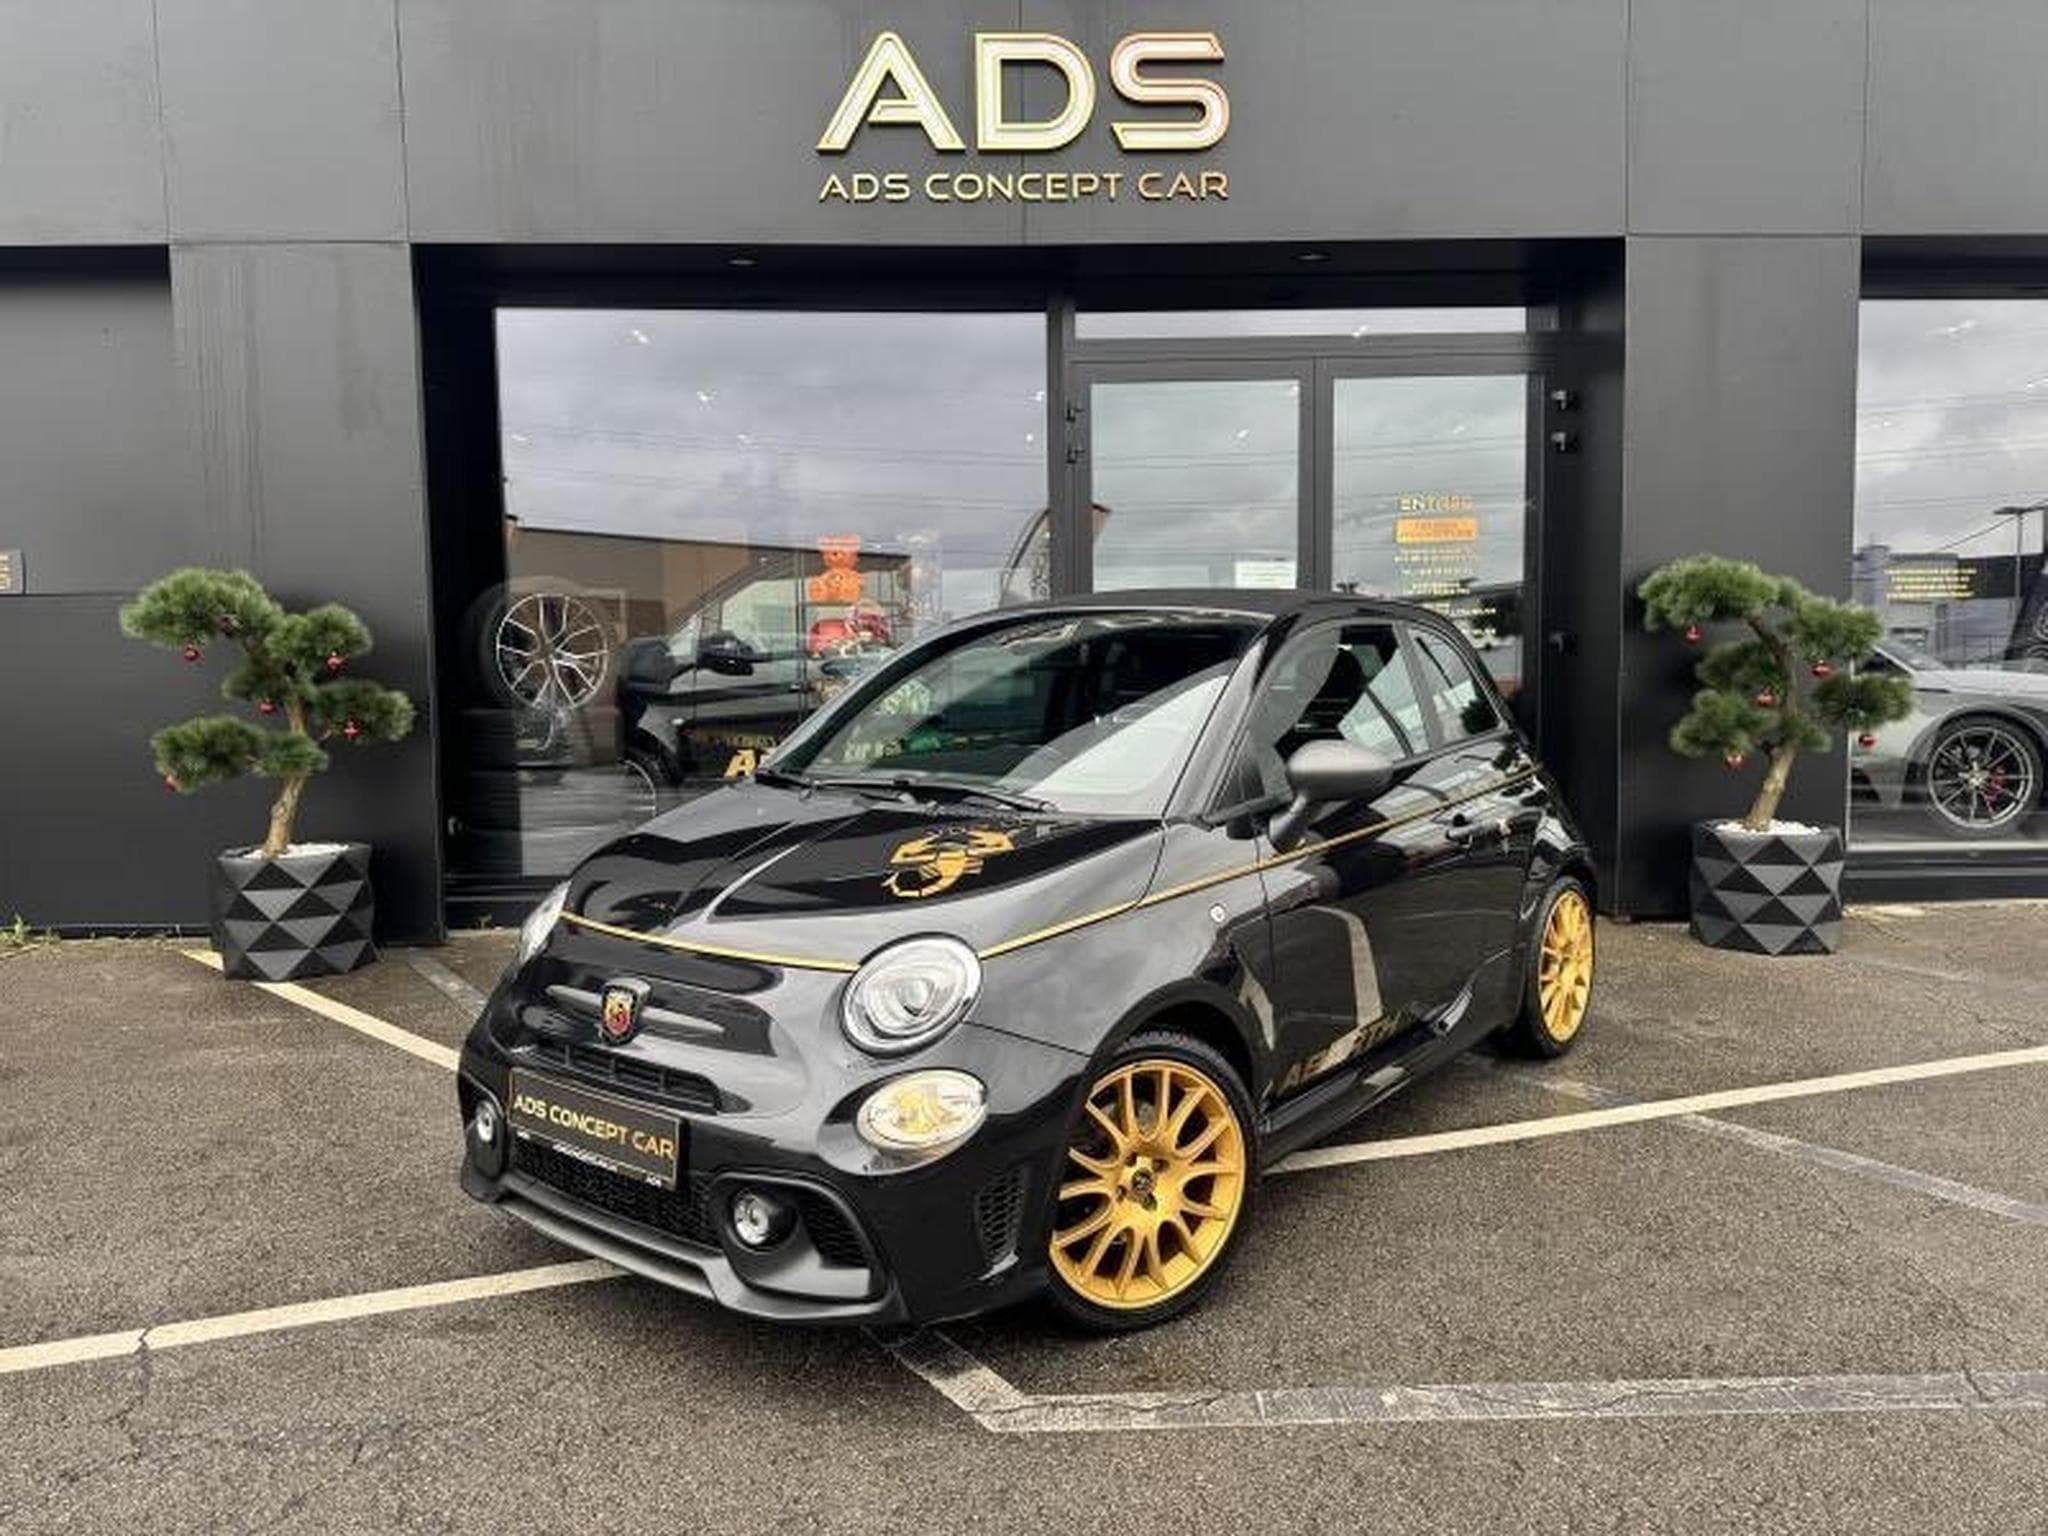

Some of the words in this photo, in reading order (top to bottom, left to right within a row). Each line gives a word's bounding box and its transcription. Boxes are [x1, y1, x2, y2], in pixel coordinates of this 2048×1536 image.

[816, 31, 1231, 151] ADS
[818, 173, 911, 201] ADS
[925, 172, 1123, 201] CONCEPT
[1137, 171, 1229, 200] CAR
[513, 1094, 547, 1119] ADS
[550, 1104, 629, 1145] CONCEPT
[632, 1131, 675, 1160] CAR
